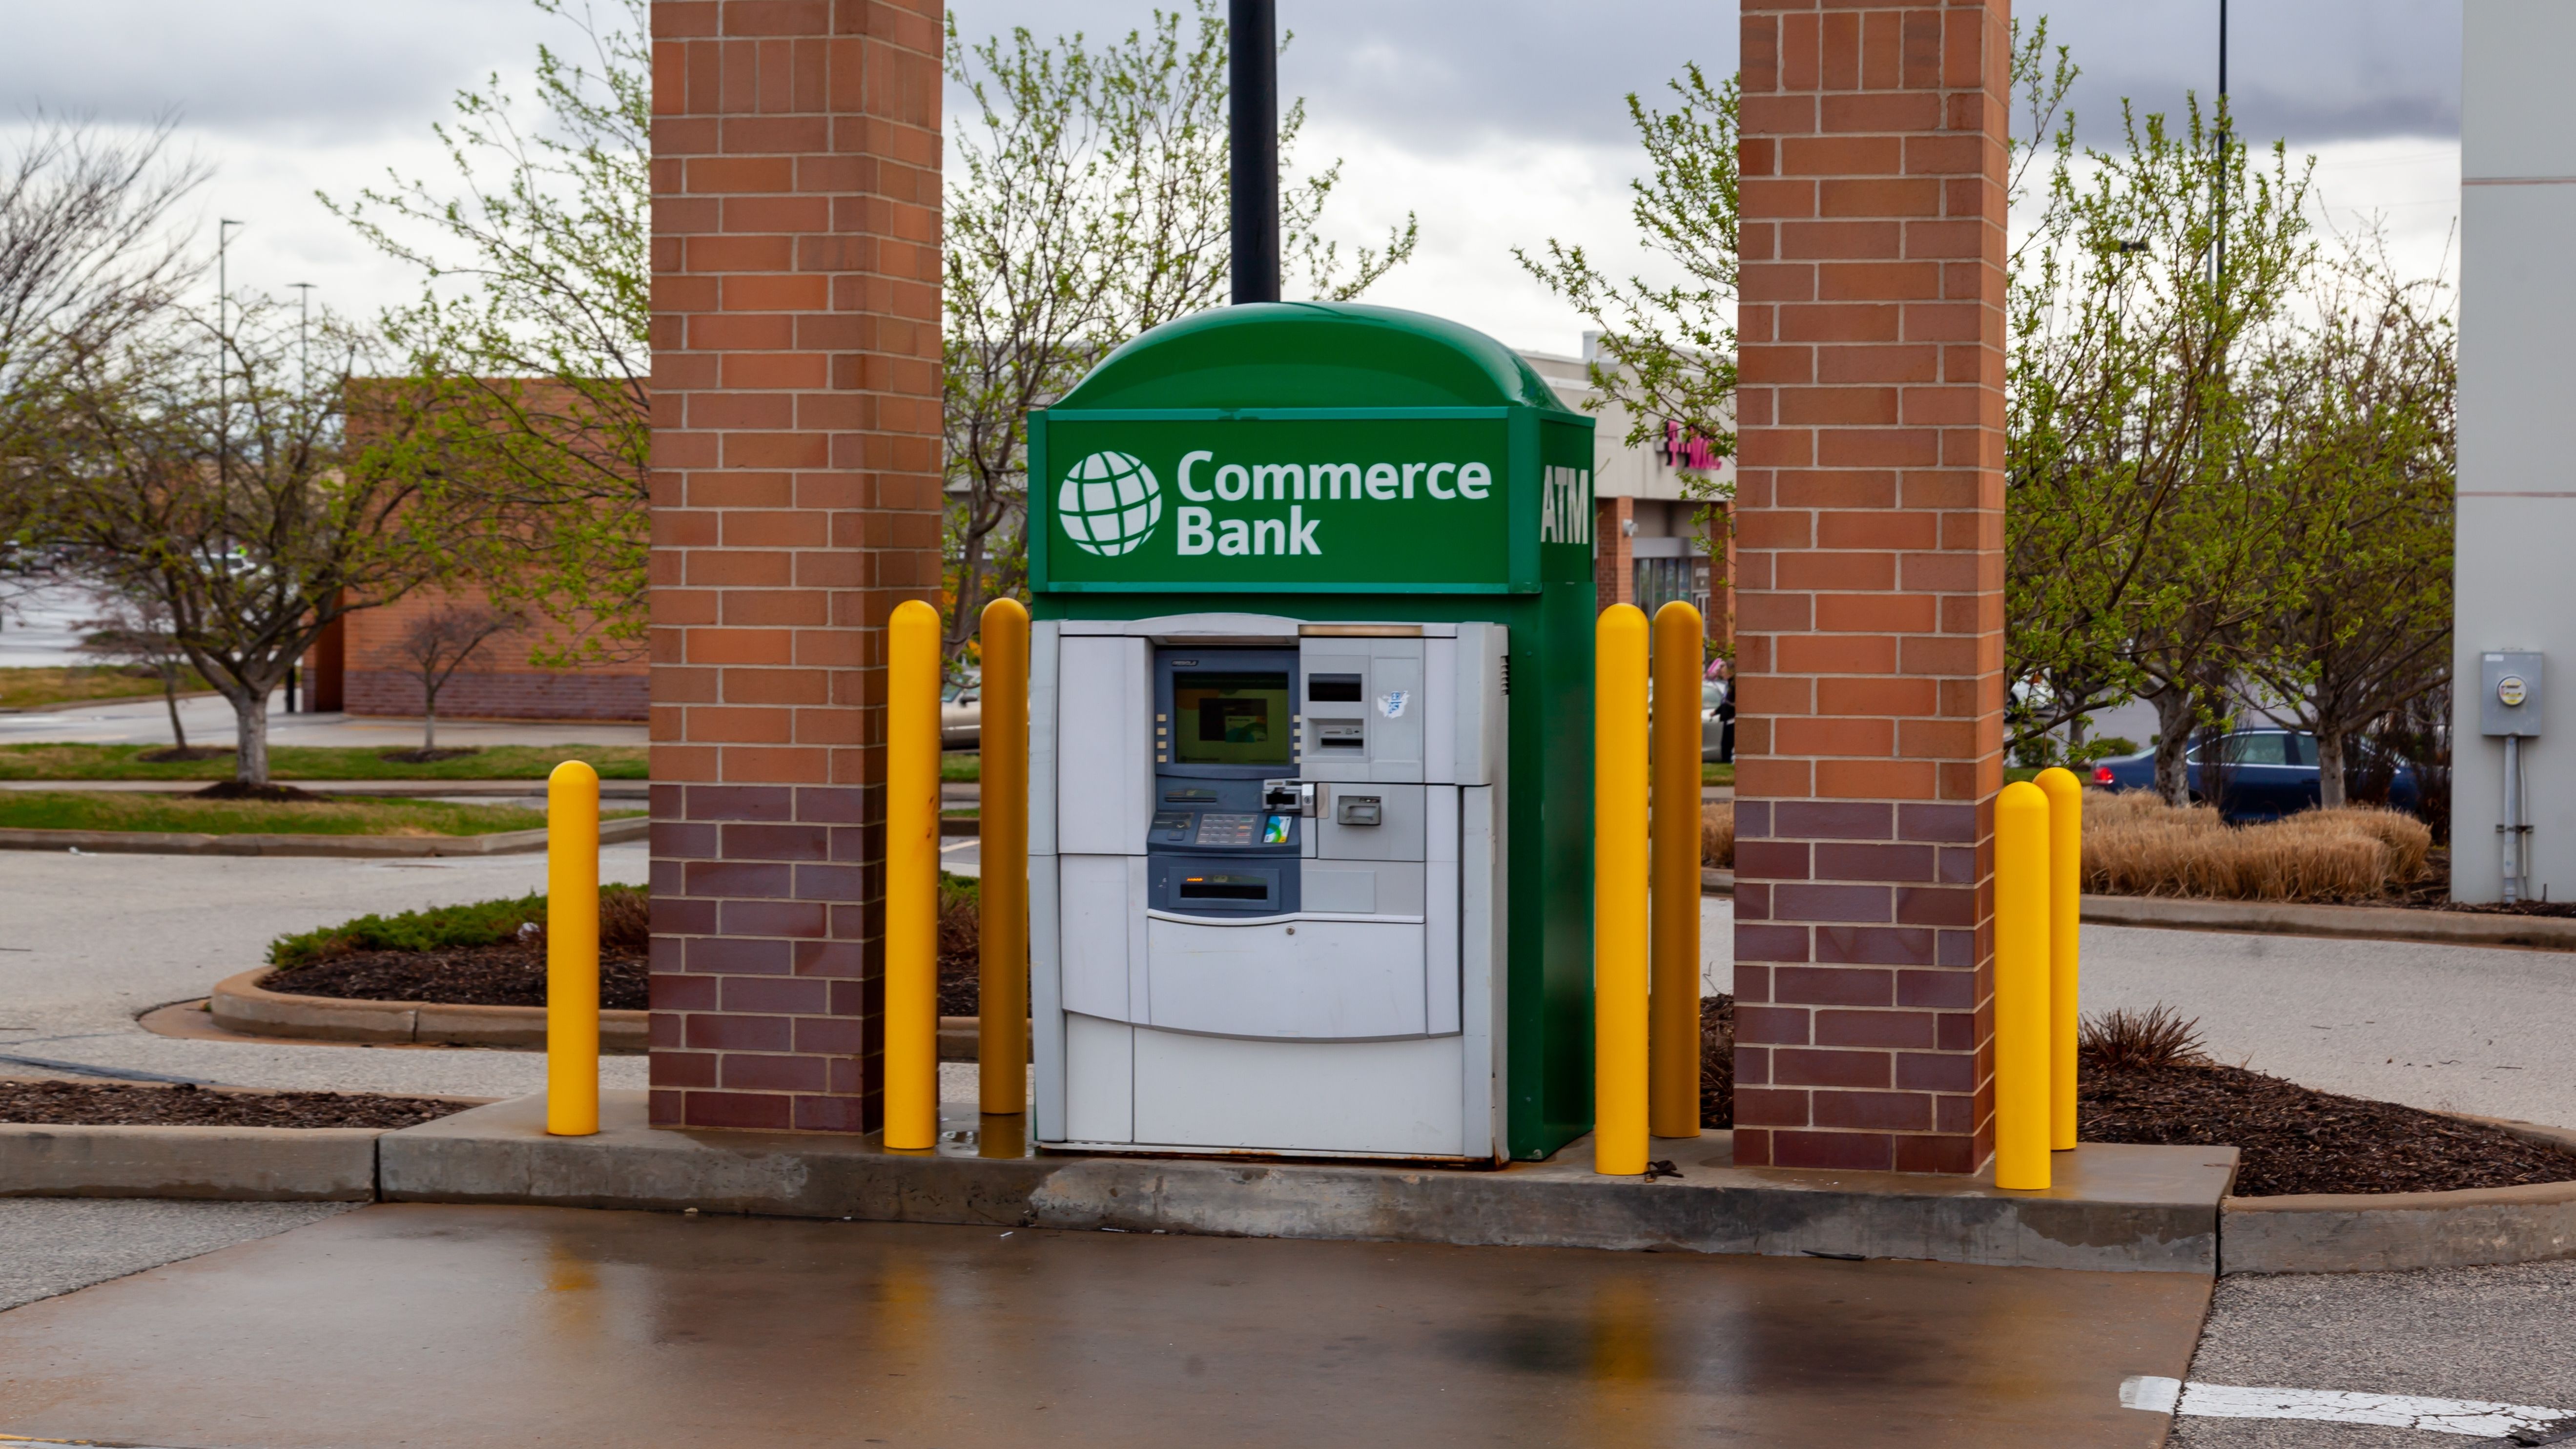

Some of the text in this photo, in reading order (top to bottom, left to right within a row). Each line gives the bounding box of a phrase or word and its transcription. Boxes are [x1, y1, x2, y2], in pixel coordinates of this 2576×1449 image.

[1177, 450, 1491, 501] Commerce
[1541, 465, 1588, 544] ATM
[1177, 505, 1322, 556] Bank
